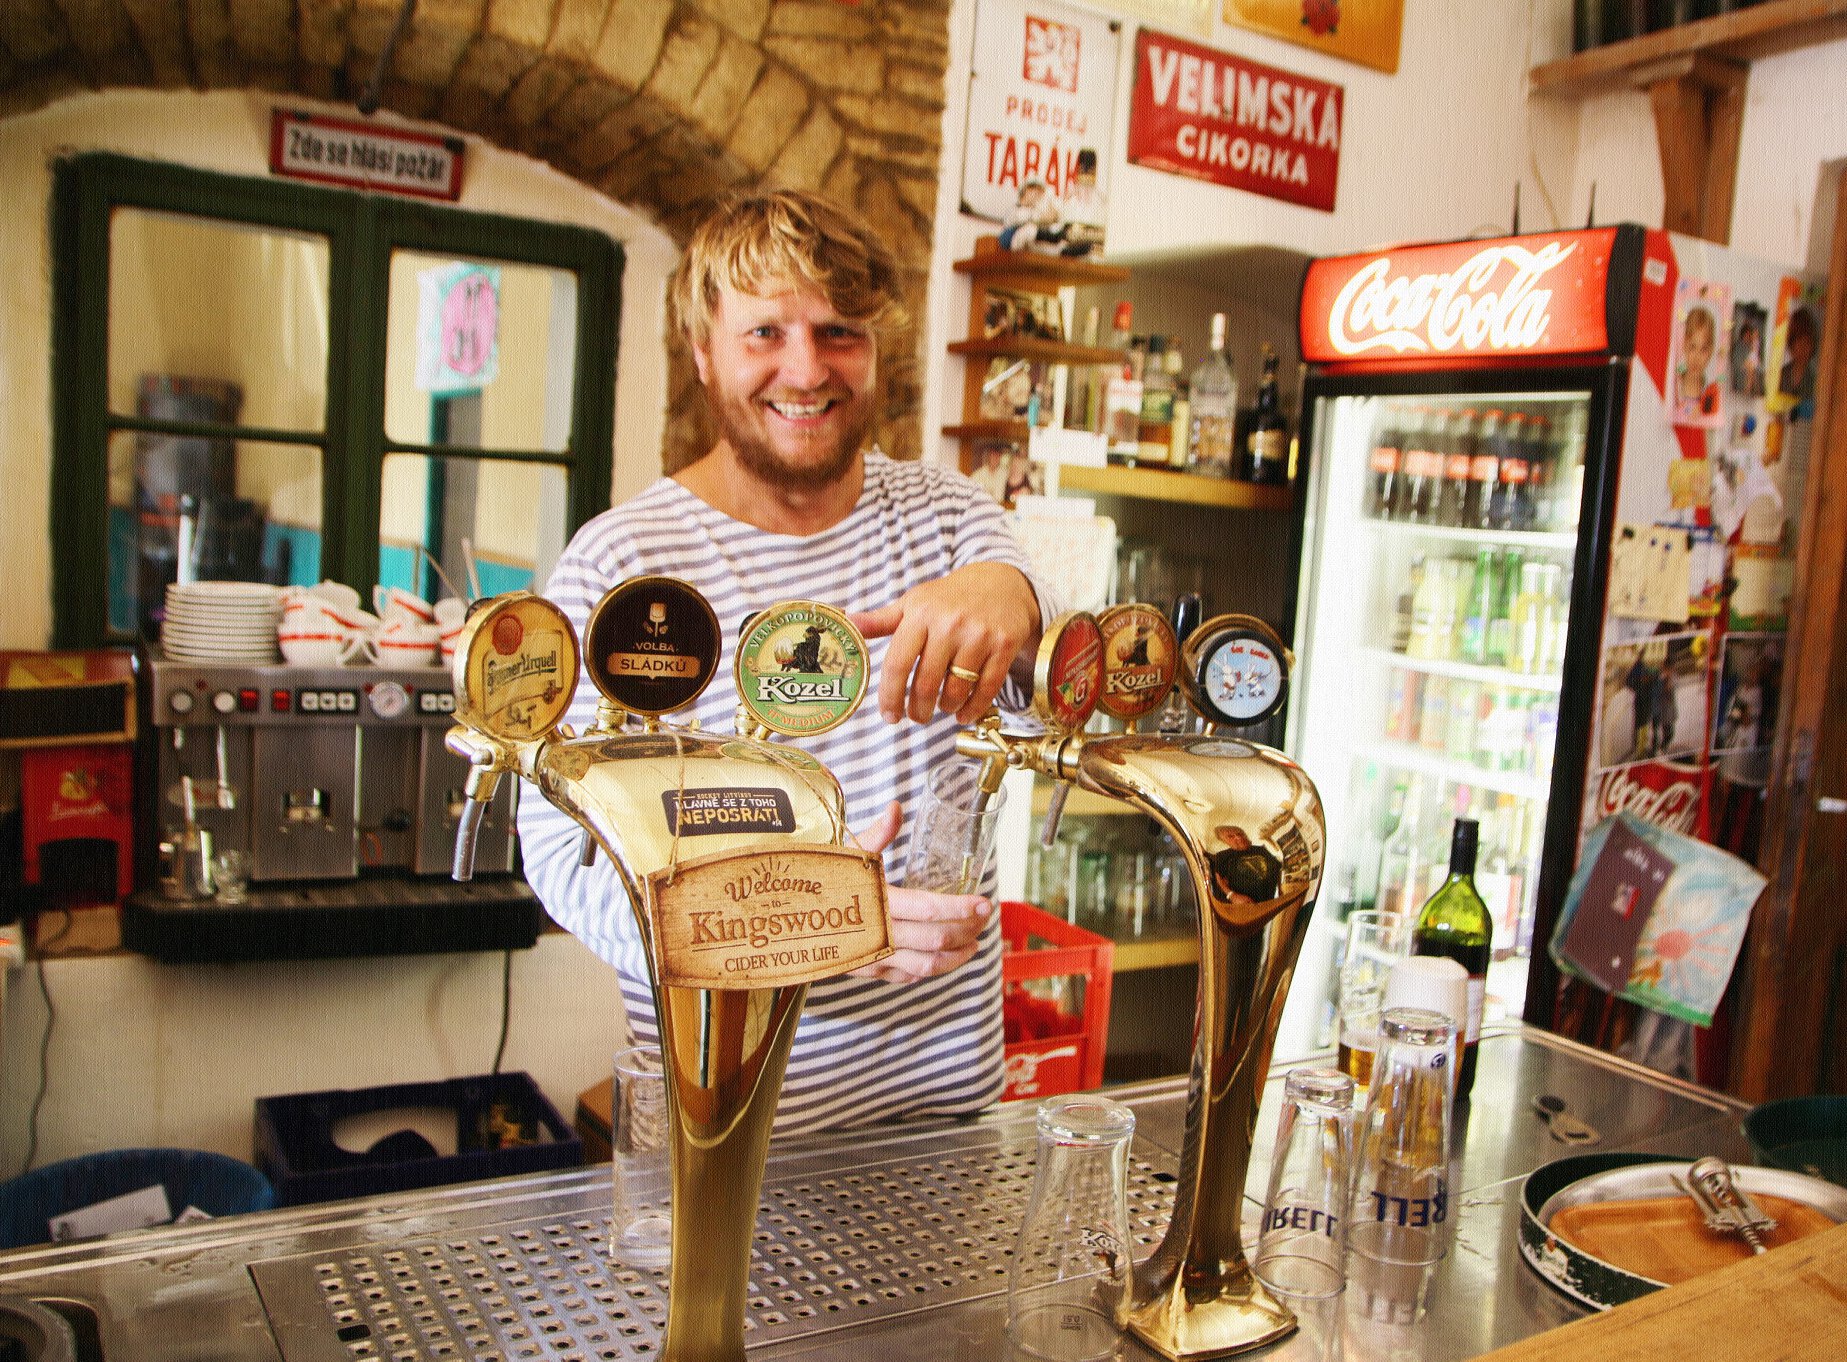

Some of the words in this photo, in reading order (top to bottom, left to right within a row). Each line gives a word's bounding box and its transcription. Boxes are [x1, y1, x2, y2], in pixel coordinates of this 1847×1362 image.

[1005, 95, 1088, 136] PRODEJ
[326, 141, 348, 166] se
[1176, 124, 1309, 187] CIKORKA
[635, 641, 675, 653] VOLBA
[756, 675, 851, 704] Kozel
[1105, 667, 1166, 694] Kozel
[722, 798, 738, 808] SE
[740, 798, 748, 807] Z
[748, 798, 777, 808] TOHO
[724, 871, 823, 903] Welcome
[689, 895, 865, 949] Kingswood
[725, 954, 769, 973] CIDER
[771, 949, 809, 968] YOUR
[811, 945, 840, 962] LIFE
